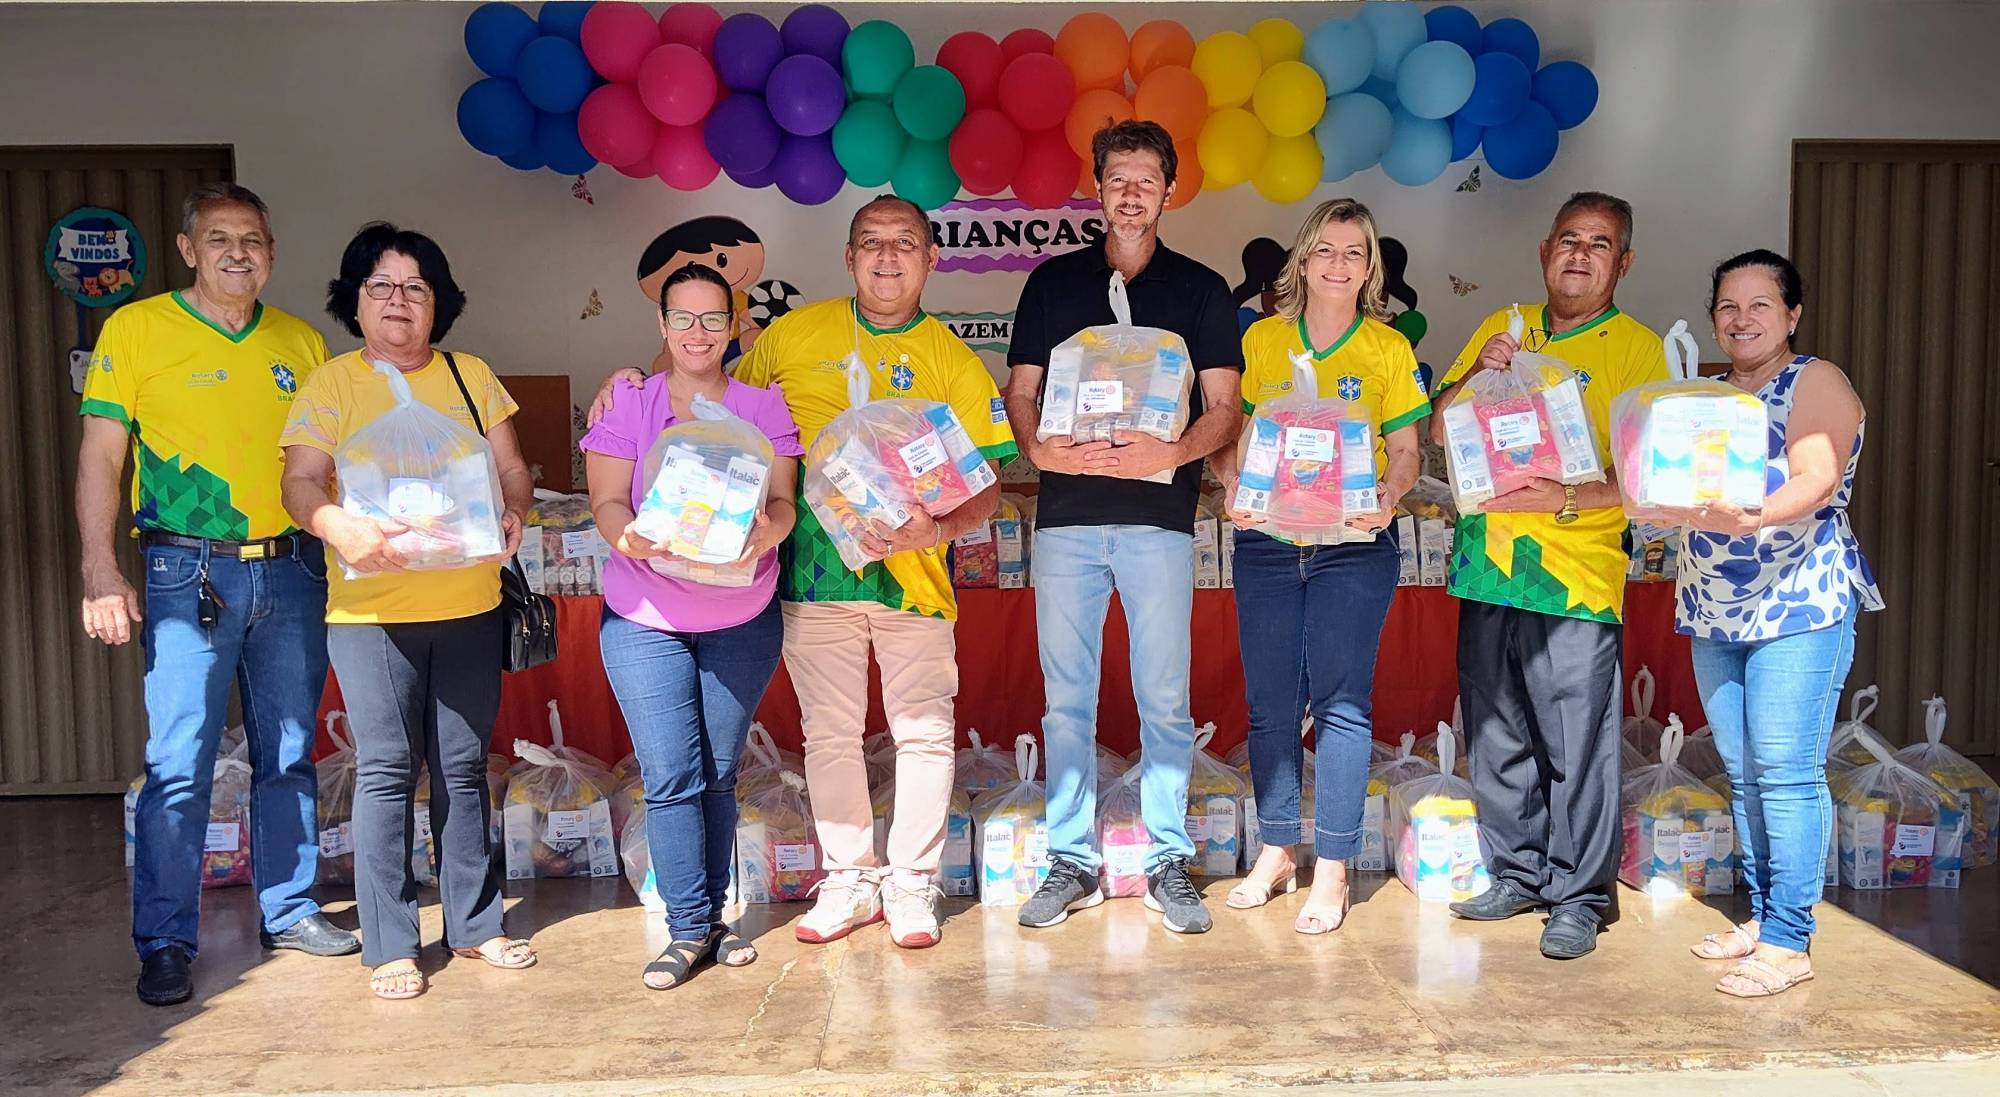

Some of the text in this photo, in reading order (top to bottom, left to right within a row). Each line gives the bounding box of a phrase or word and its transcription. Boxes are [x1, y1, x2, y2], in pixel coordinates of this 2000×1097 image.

[930, 219, 1103, 254] RIANÇAS
[71, 248, 120, 260] VINDOS
[1298, 432, 1317, 441] Rotary
[730, 467, 760, 485] Italac
[830, 467, 851, 484] Italac
[1209, 806, 1233, 816] Italac
[986, 833, 1011, 842] Italac
[1657, 828, 1681, 837] Italac
